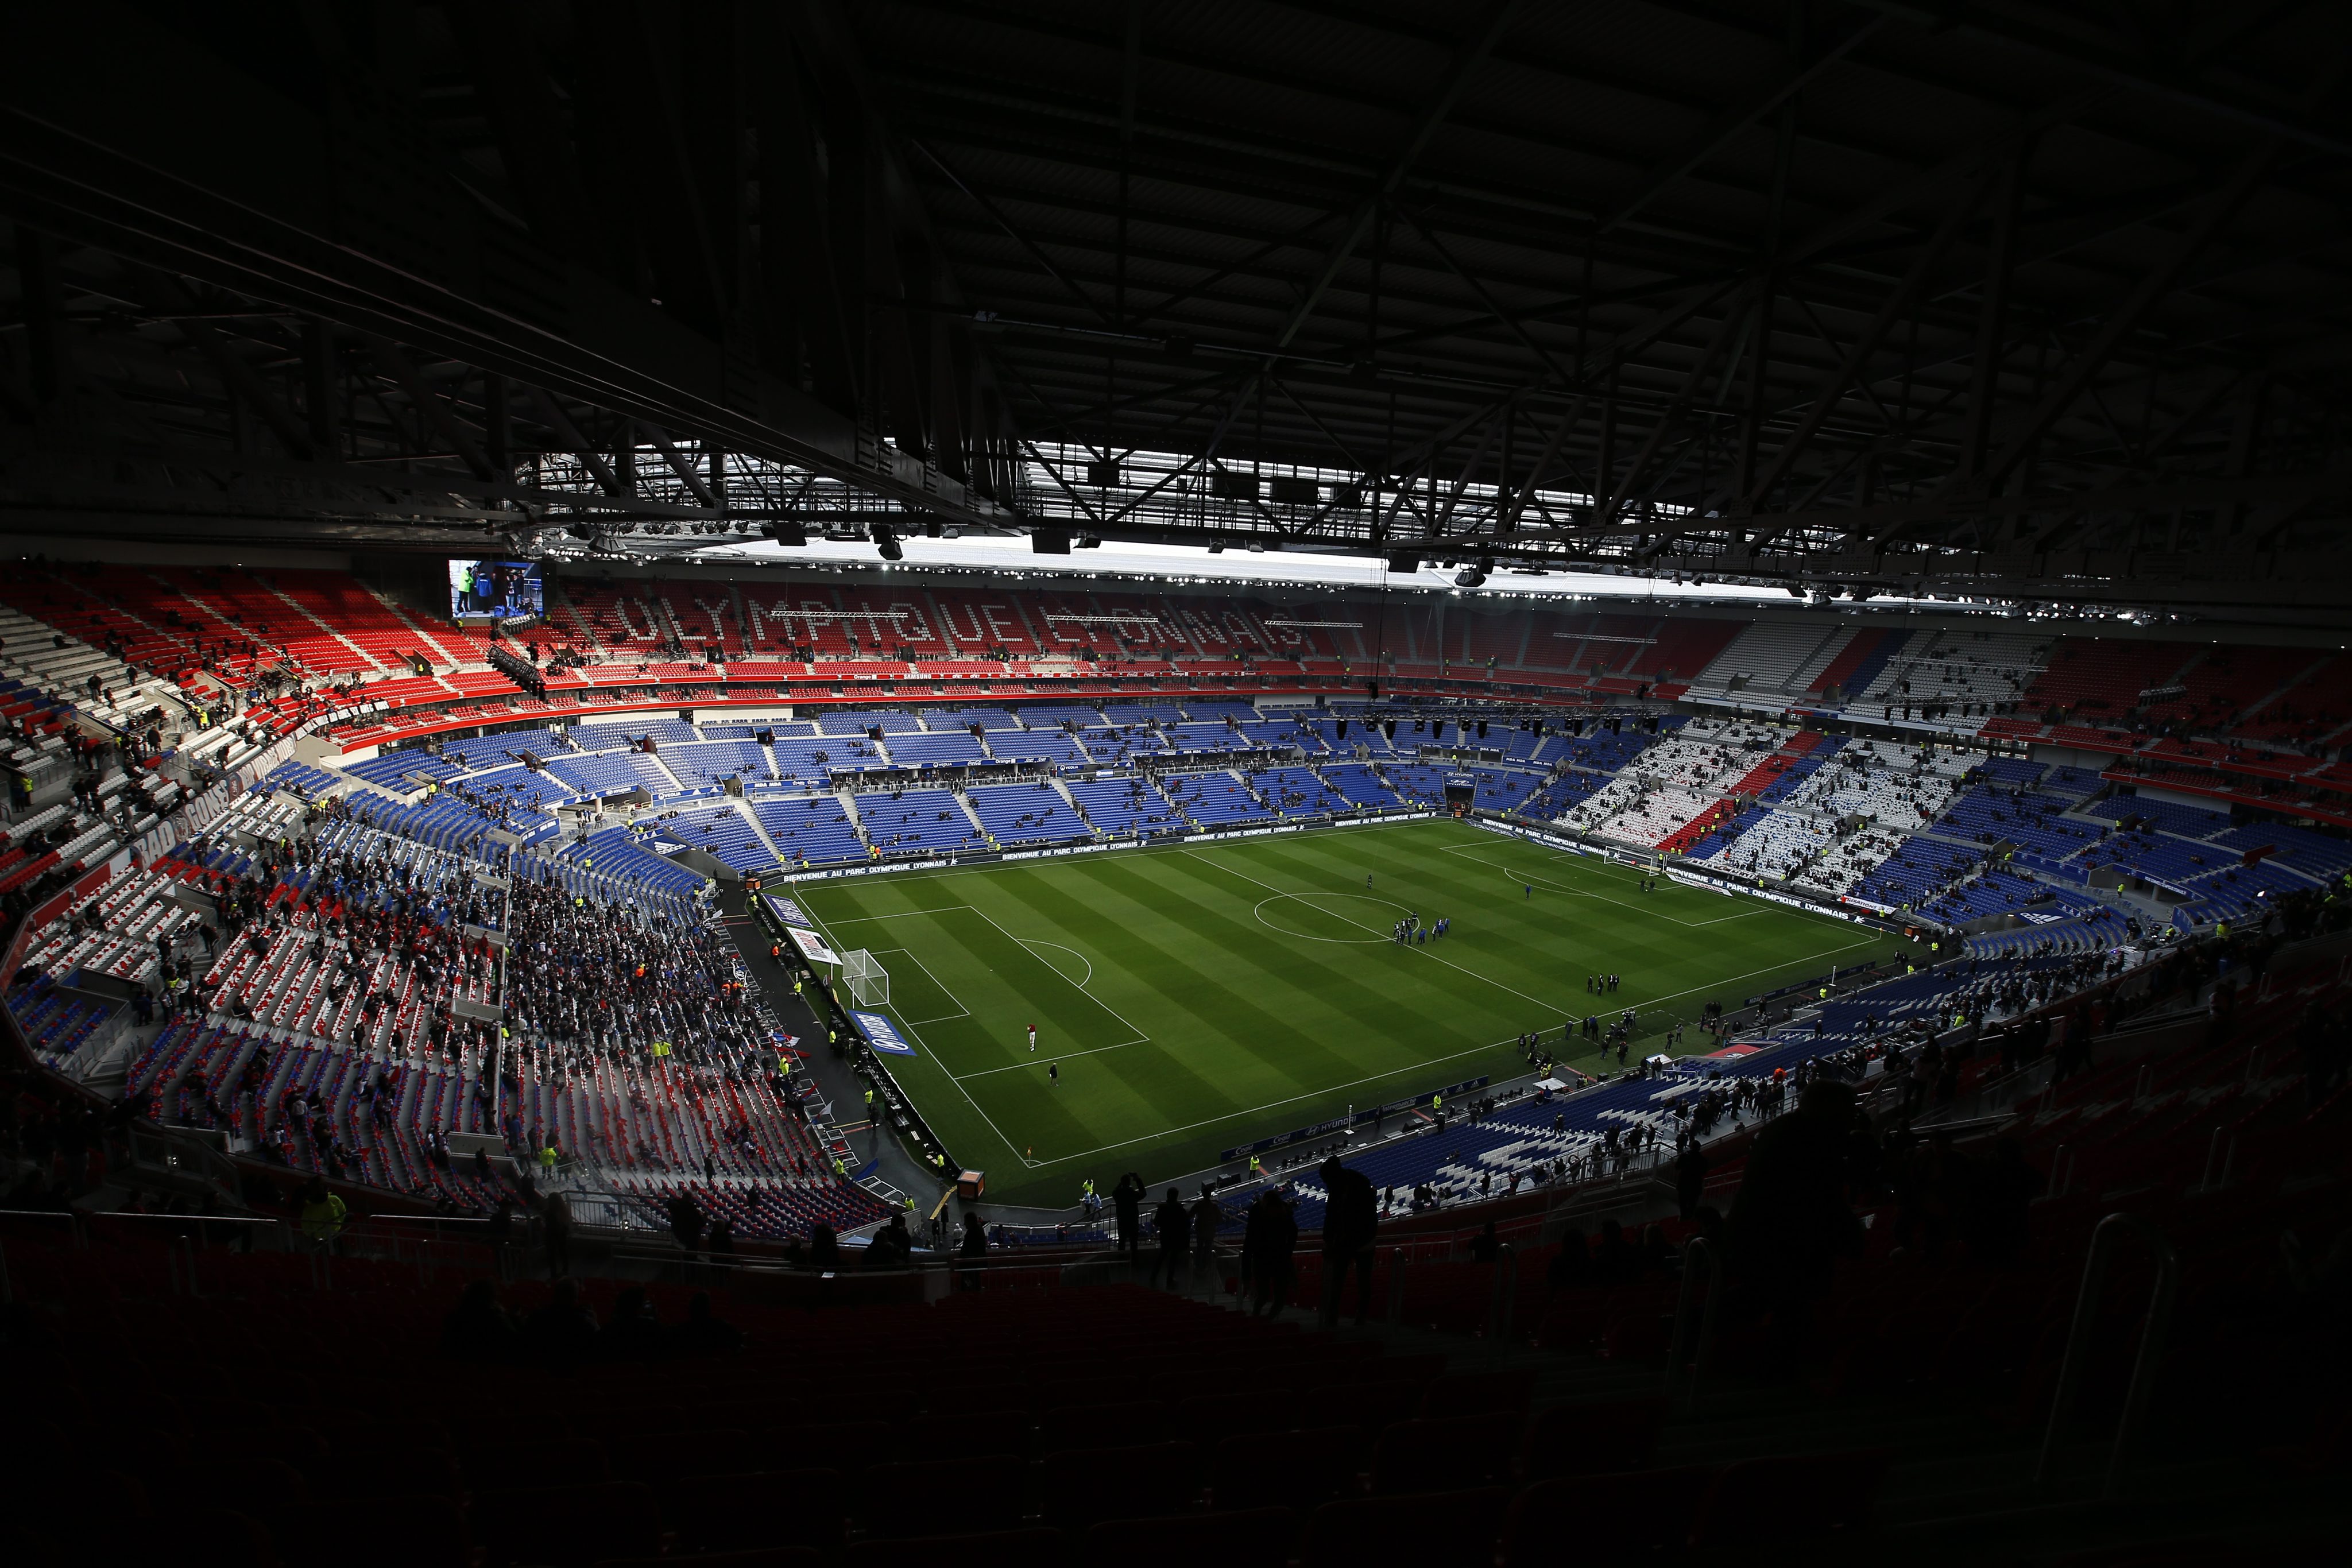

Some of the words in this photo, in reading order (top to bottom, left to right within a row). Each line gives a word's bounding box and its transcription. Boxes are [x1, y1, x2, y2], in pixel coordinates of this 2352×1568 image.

[614, 597, 1023, 641] OLYMPIQUE
[1184, 834, 1215, 842] BIENVENUE
[1243, 828, 1272, 836] OLYMPIQUE
[1483, 818, 1512, 831] BIENVENUE
[1526, 830, 1541, 838] PARC
[1544, 834, 1577, 848] OLYMPIQUE
[1579, 844, 1610, 856] LYONNAIS
[657, 843, 687, 855] adidas
[1003, 851, 1039, 860] BIENVENUE
[1073, 844, 1108, 853] OLYMPIQUE
[784, 872, 827, 882] BIENVENUE
[845, 868, 865, 876] PARC
[869, 863, 910, 873] OLYMPIQUE
[913, 861, 947, 869] LYONNAIS
[1666, 866, 1709, 882] BIENVENUE
[1726, 882, 1749, 893] PARC
[1752, 889, 1801, 907] OLYMPIQUE
[1804, 903, 1849, 920] LYONNAIS
[856, 1013, 898, 1040] HYUNDAI
[1321, 1116, 1357, 1132] HYUNDAI
[1274, 1133, 1291, 1144] Cegid
[1235, 1144, 1254, 1155] Cegid
